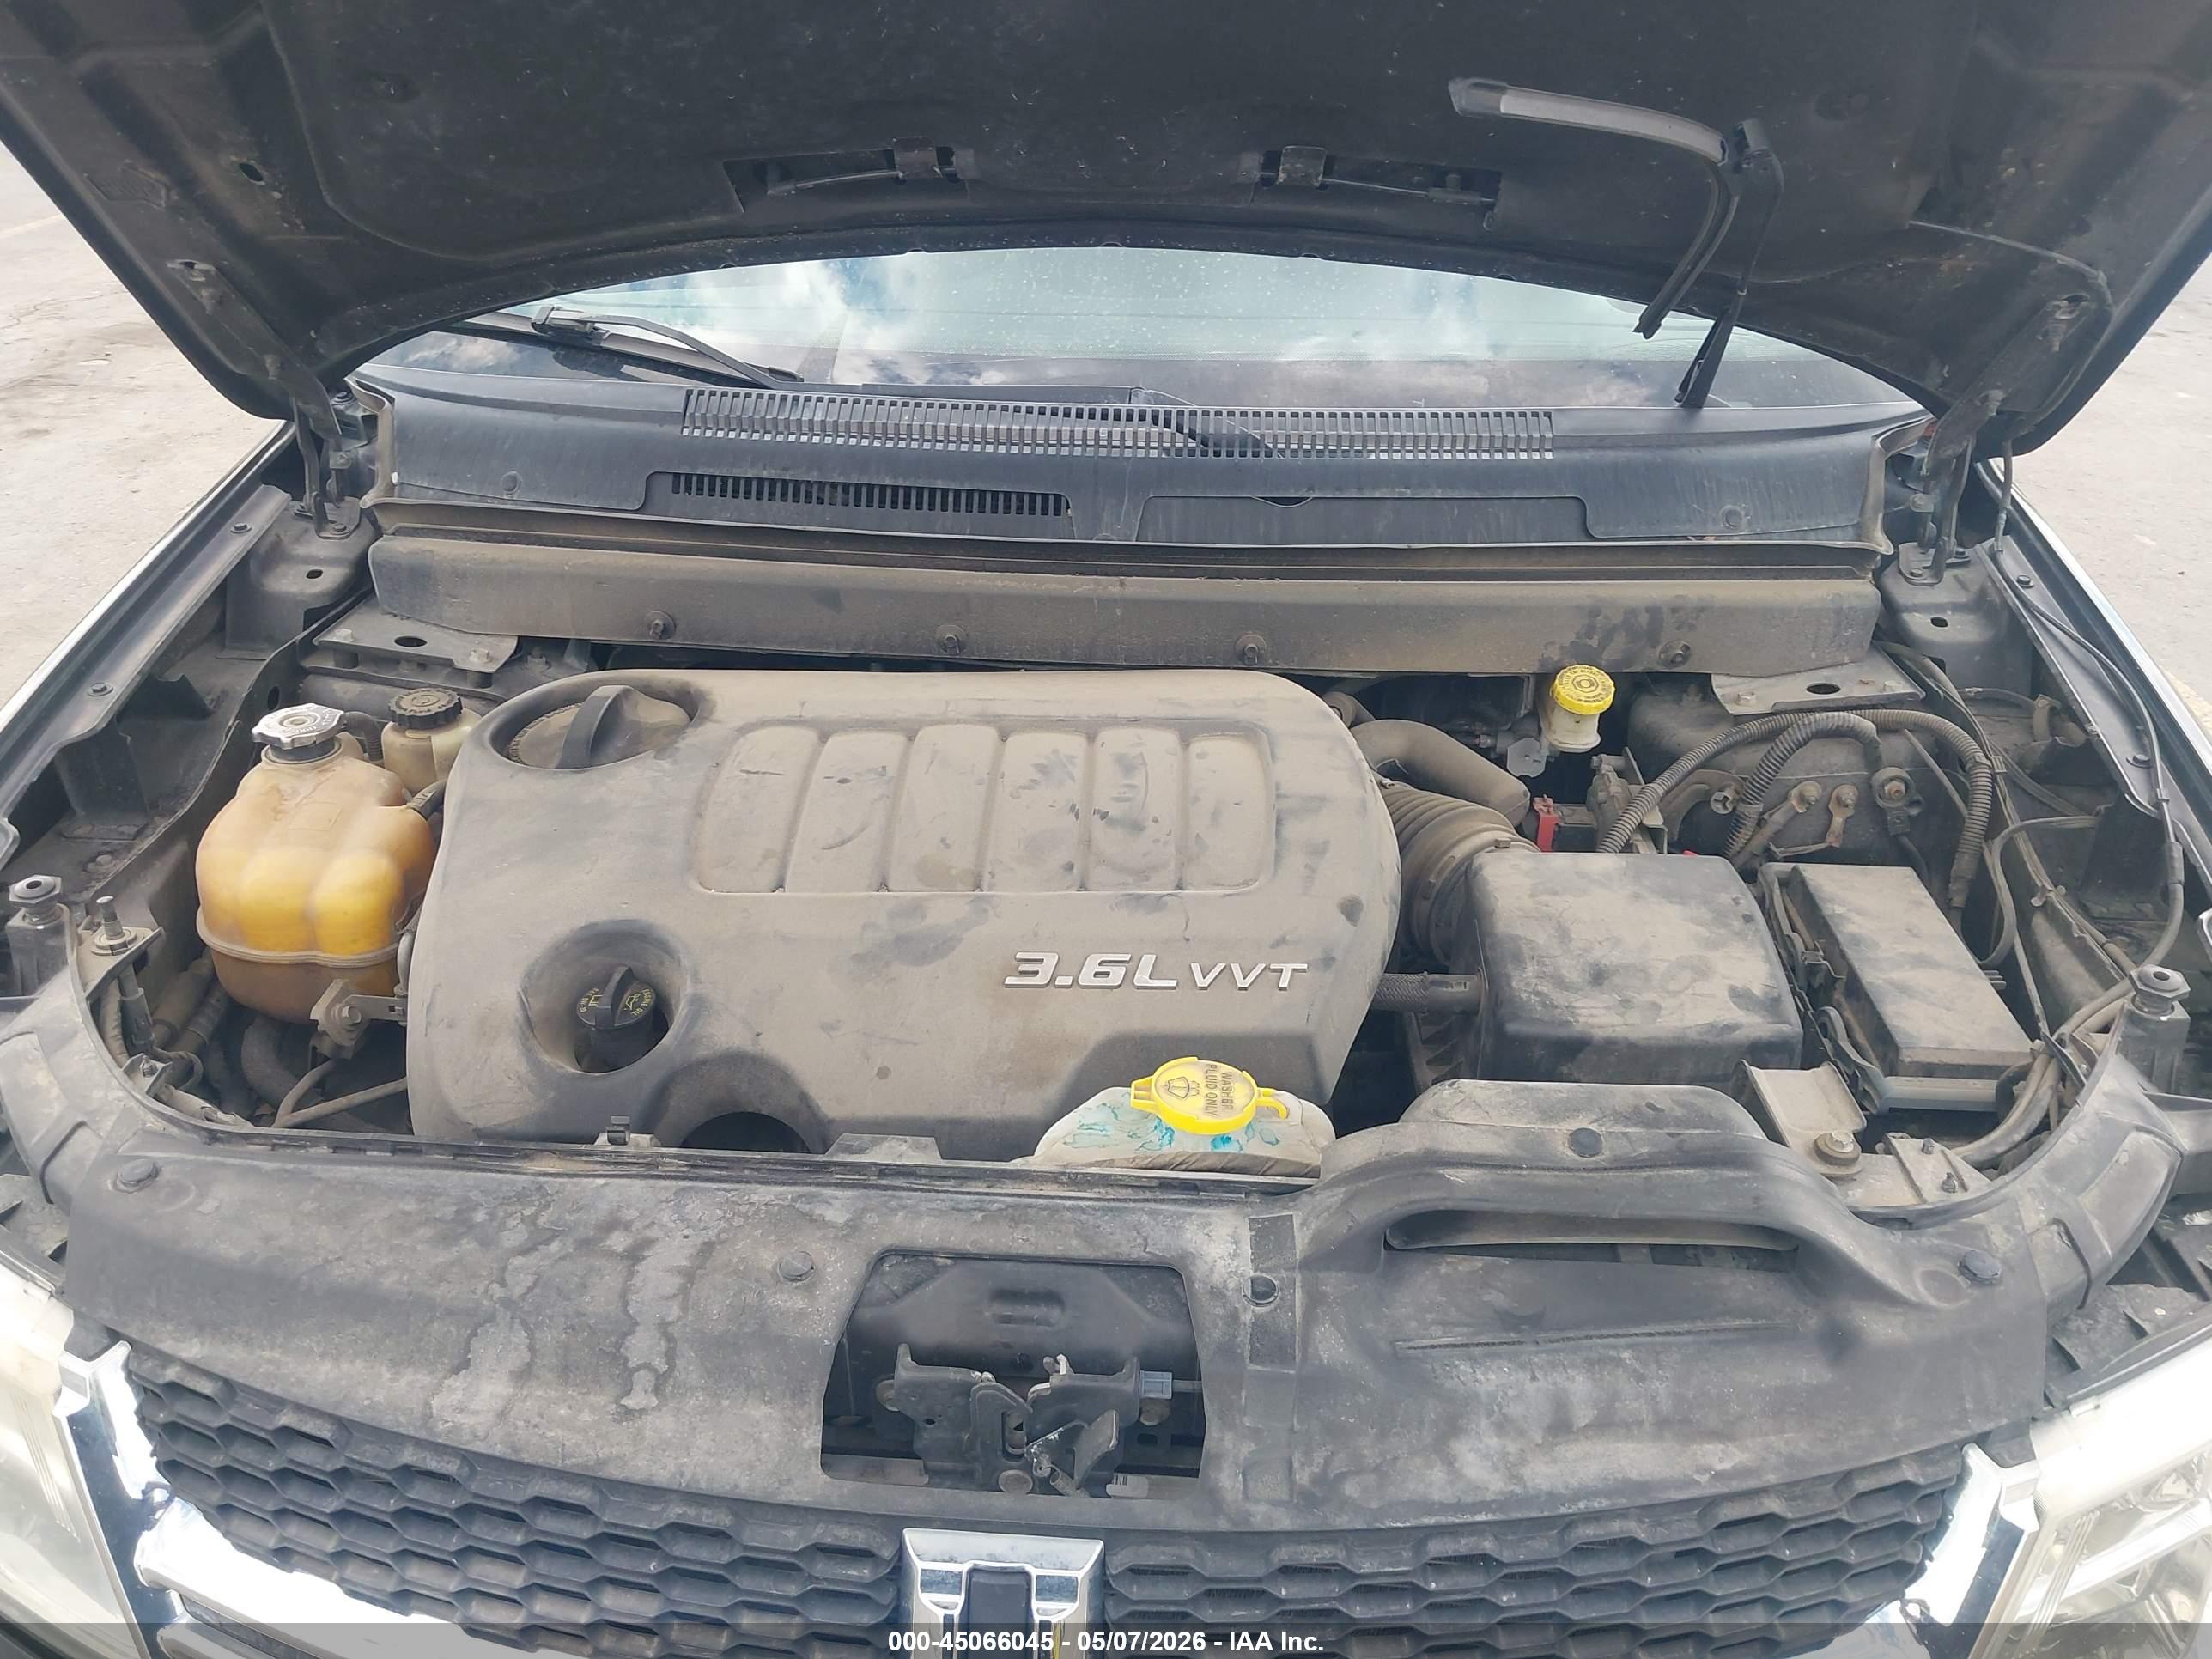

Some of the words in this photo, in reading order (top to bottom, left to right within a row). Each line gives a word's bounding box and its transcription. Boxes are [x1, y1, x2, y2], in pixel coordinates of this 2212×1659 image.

[1004, 951, 1178, 989] 3.6L
[1190, 962, 1309, 991] VVT
[631, 1007, 644, 1017] OIL
[1204, 1091, 1218, 1116] ONLY
